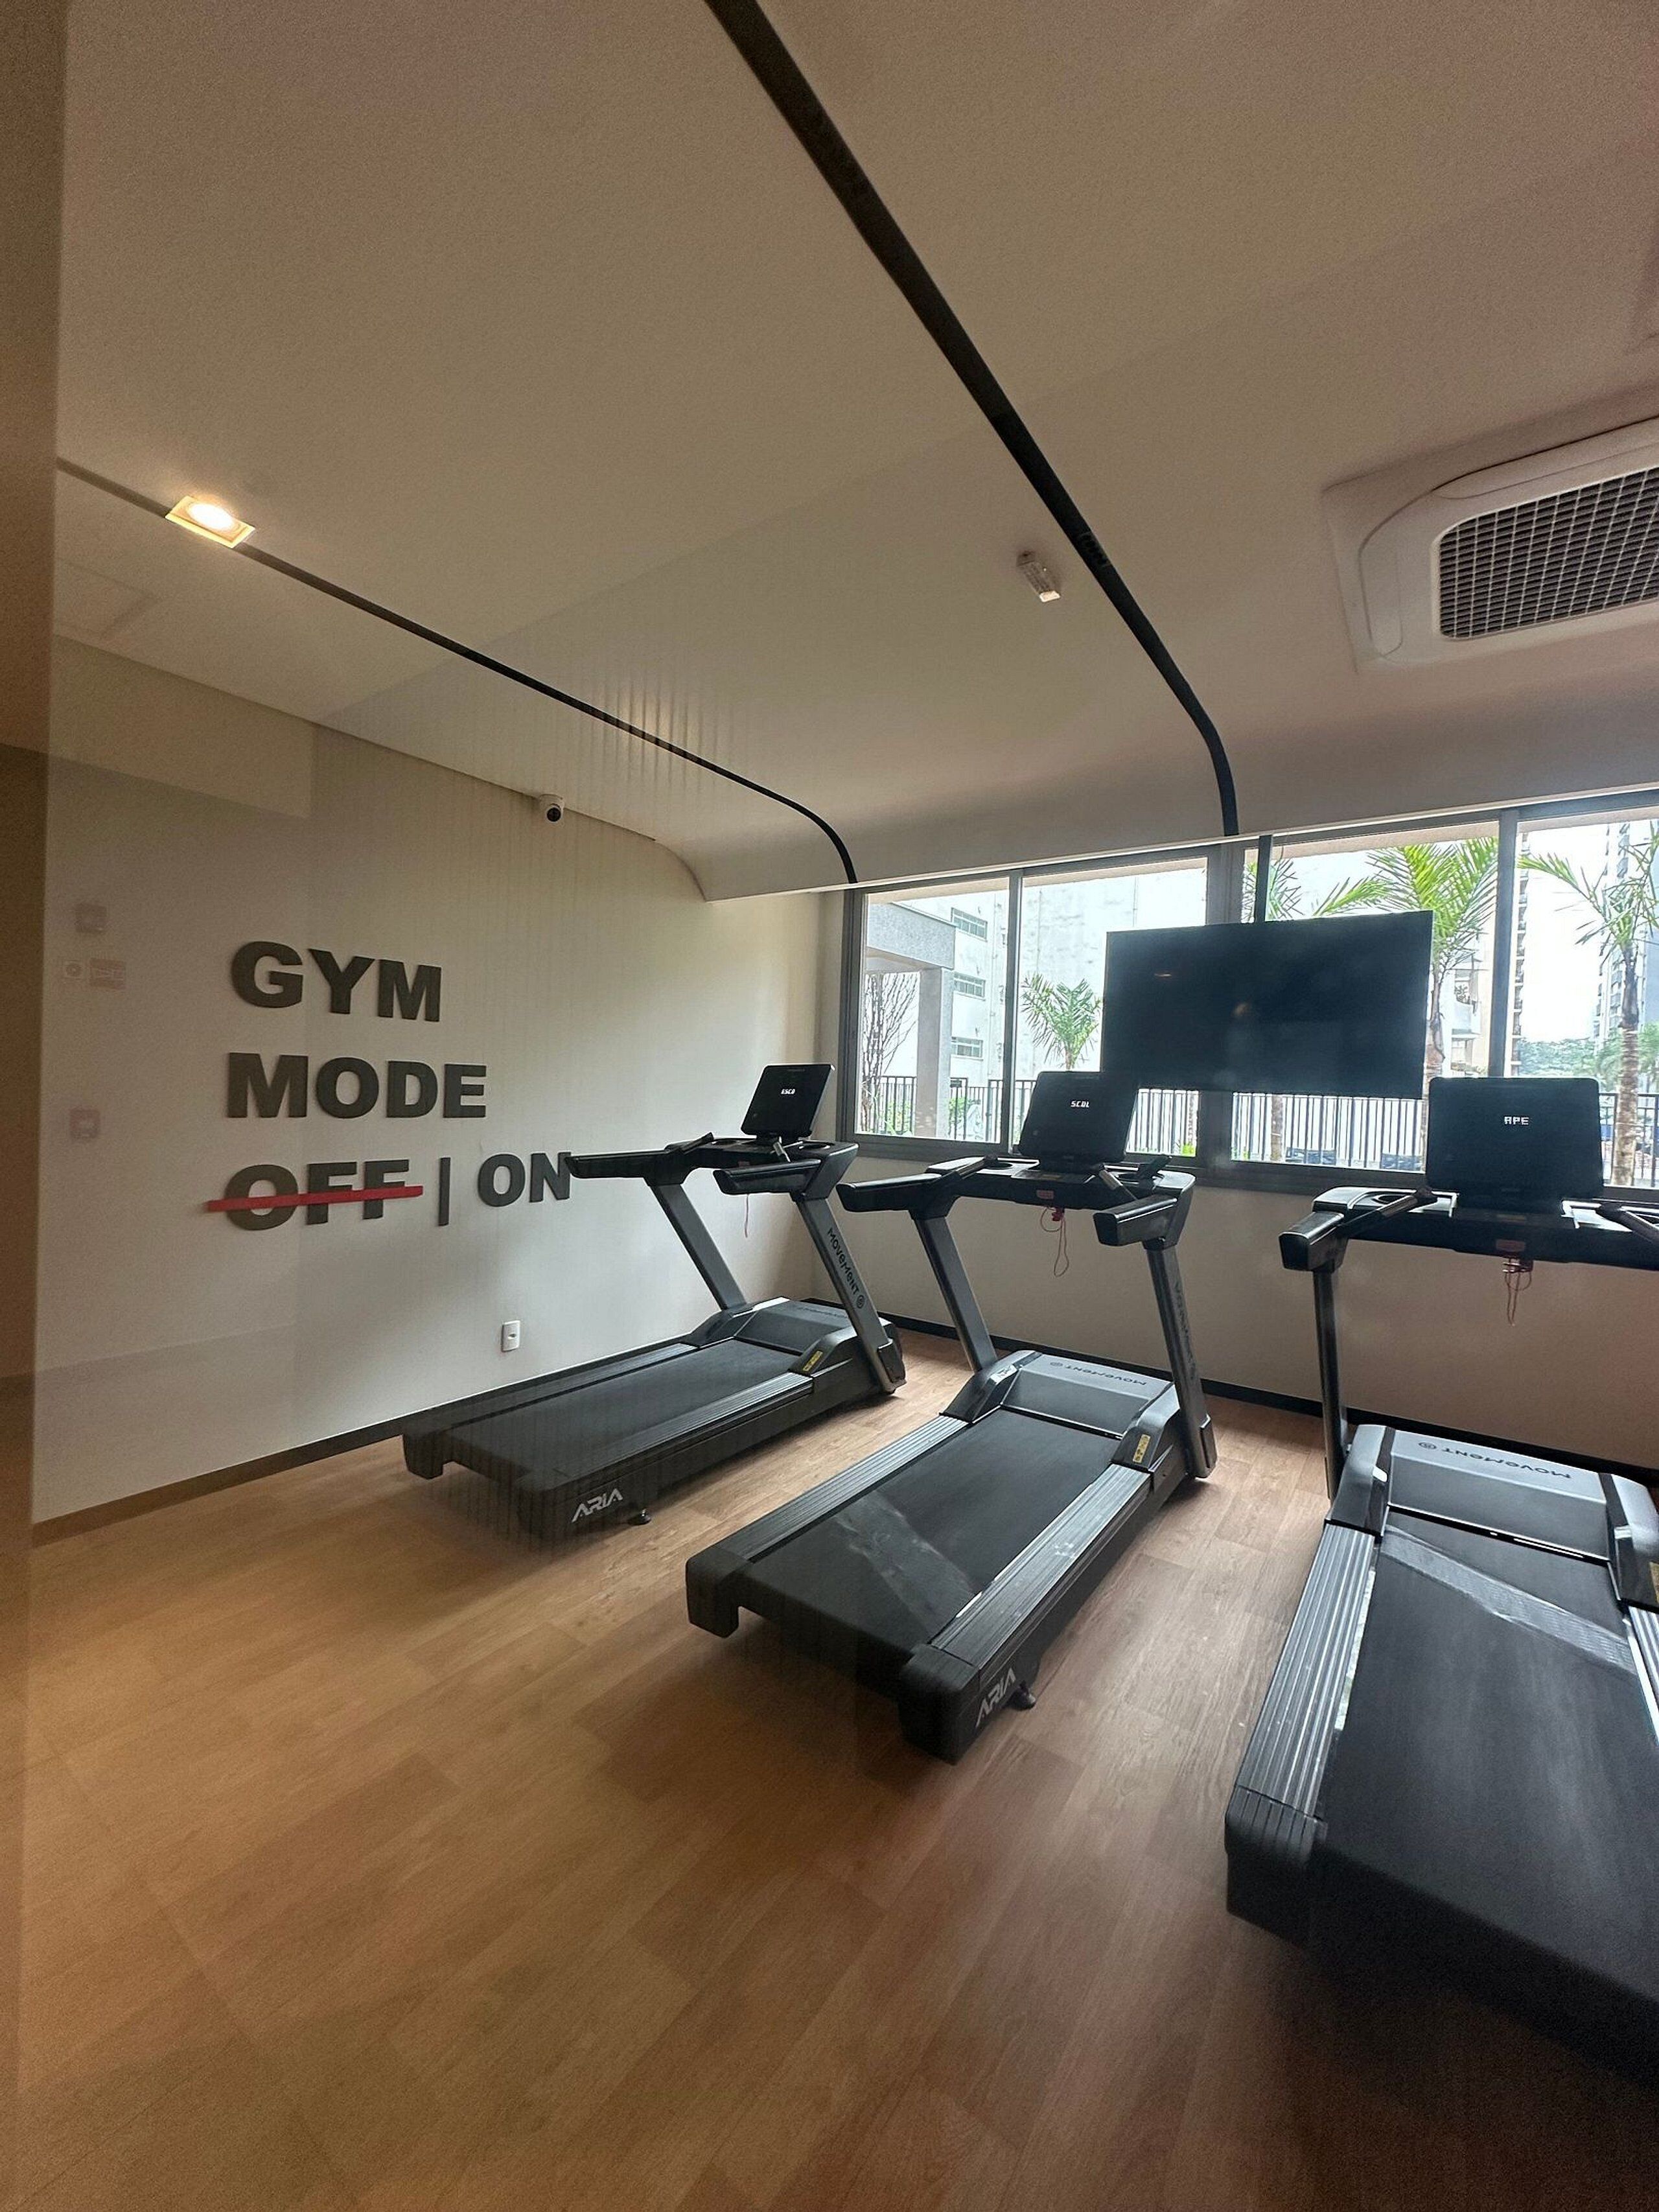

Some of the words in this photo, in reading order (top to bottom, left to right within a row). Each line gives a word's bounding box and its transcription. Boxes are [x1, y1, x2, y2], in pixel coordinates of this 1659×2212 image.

[231, 941, 442, 1022] GYM
[227, 1053, 487, 1119] MODE
[224, 1159, 410, 1231] OFF
[478, 1152, 572, 1207] ON
[572, 1488, 623, 1523] ARIA
[975, 1667, 1016, 1728] ARIA
